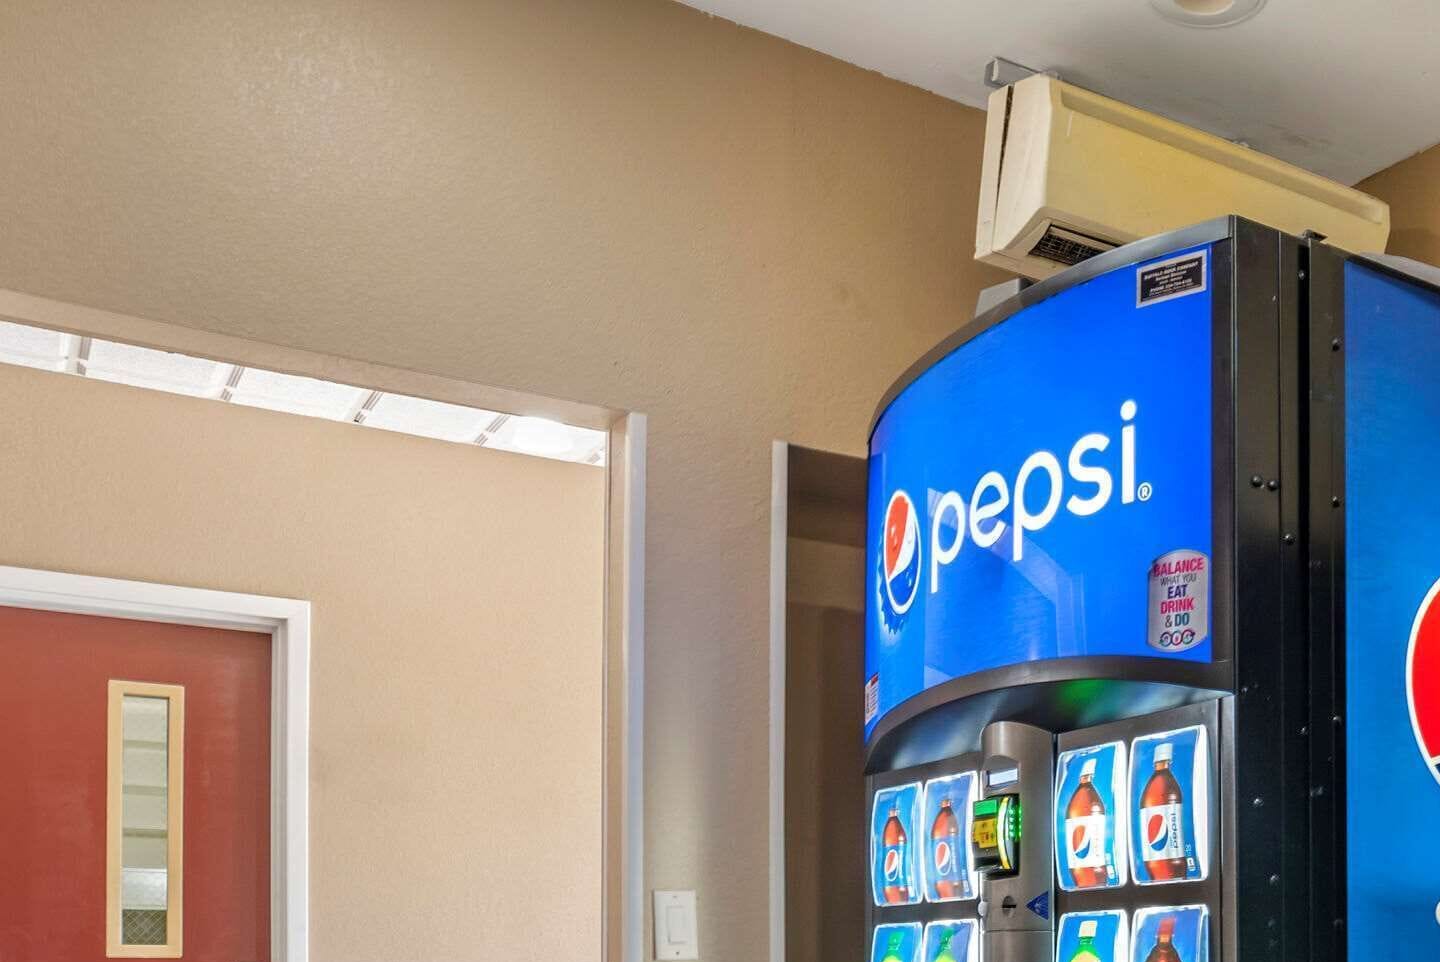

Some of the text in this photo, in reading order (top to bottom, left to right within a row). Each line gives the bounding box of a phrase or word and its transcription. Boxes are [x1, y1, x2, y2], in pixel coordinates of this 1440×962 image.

[930, 399, 1137, 595] pepsi
[1153, 557, 1204, 577] BALANCE
[1160, 572, 1197, 586] WHAT YOU
[1167, 584, 1187, 599] EAT
[1160, 597, 1194, 614] DRINK
[1165, 612, 1190, 628] & DO
